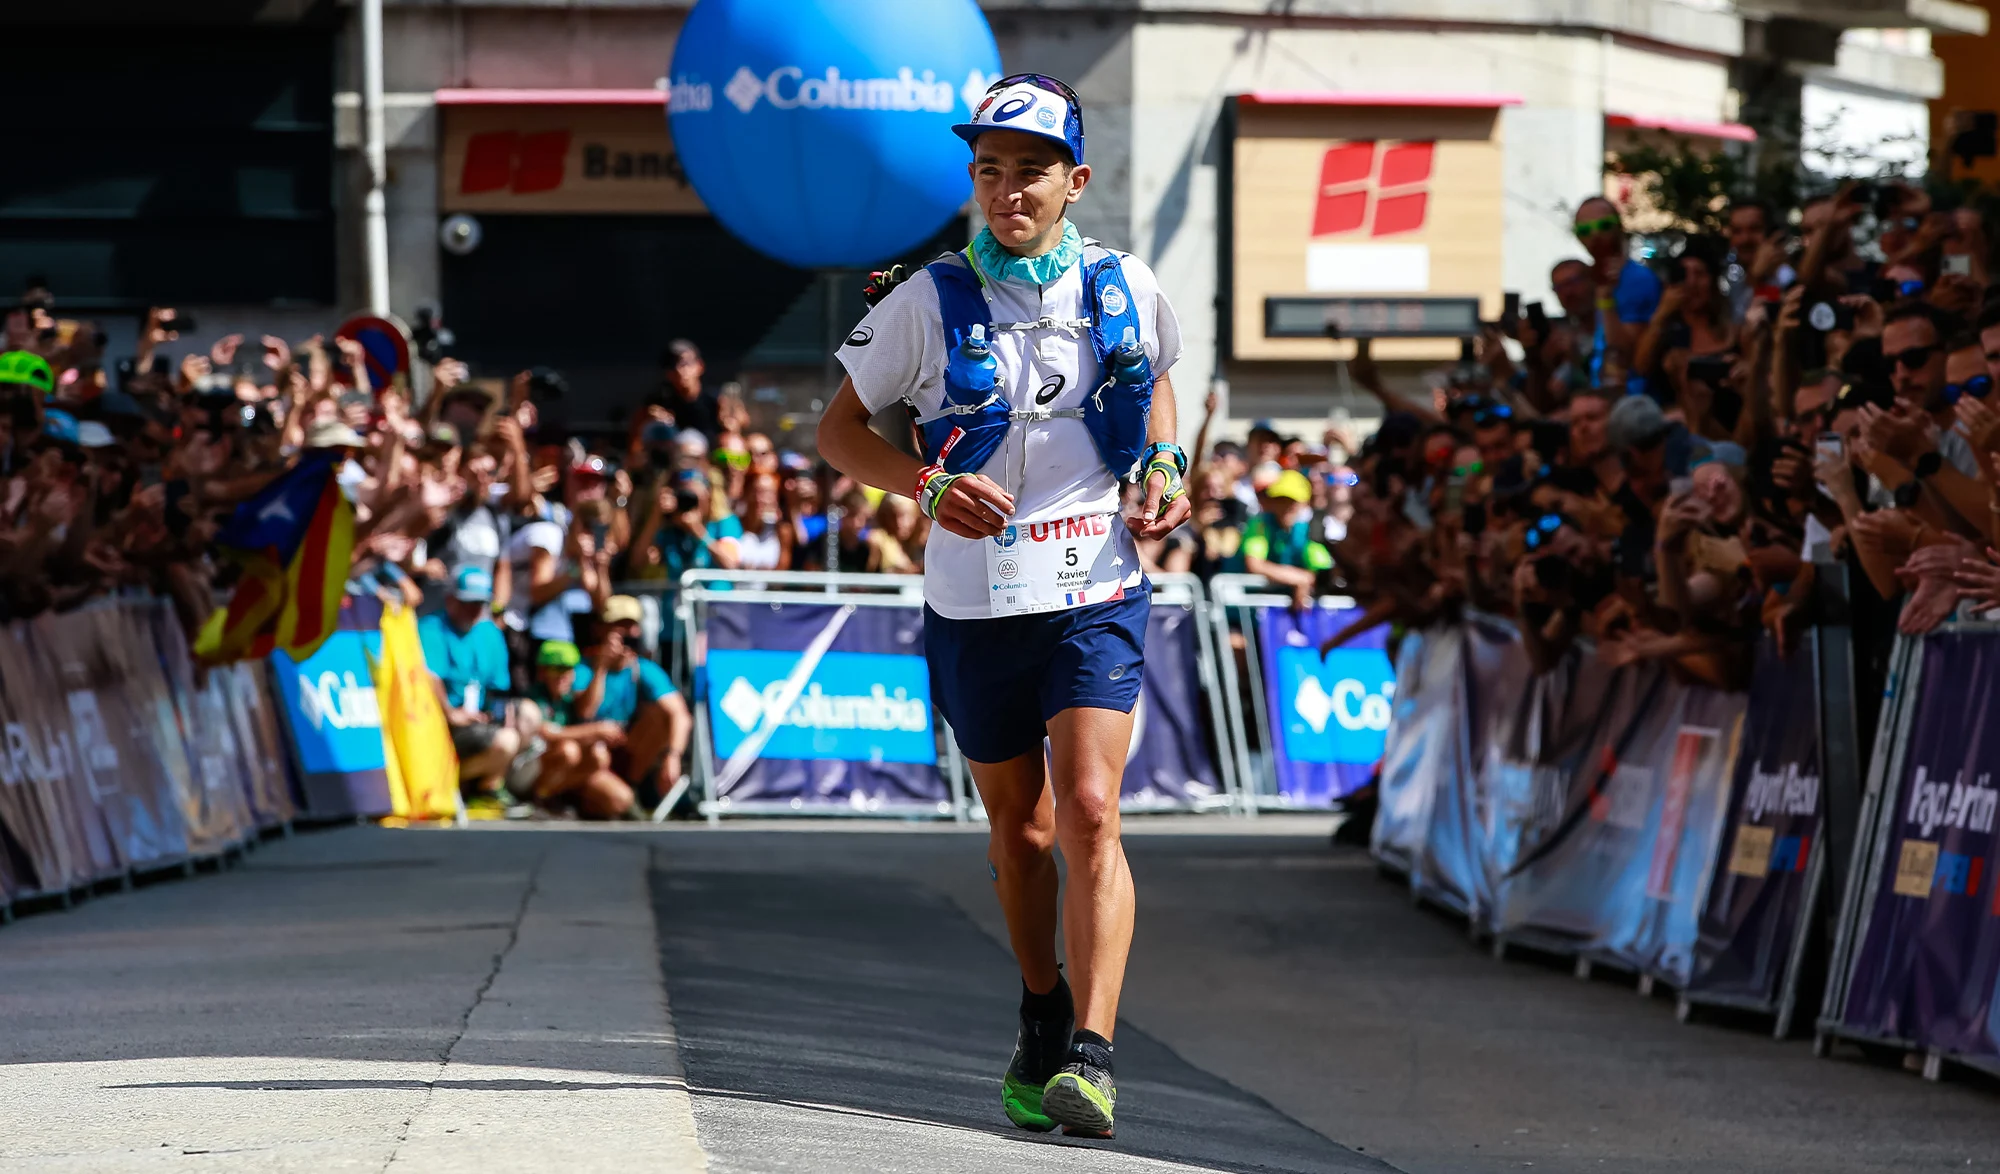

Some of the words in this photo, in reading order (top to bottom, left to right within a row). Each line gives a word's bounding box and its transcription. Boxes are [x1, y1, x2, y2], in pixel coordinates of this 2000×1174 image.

[767, 66, 954, 113] Columbia
[1031, 515, 1106, 542] UTMB
[1065, 548, 1078, 566] 5
[1056, 569, 1089, 580] Xavier
[999, 582, 1028, 591] Columbia
